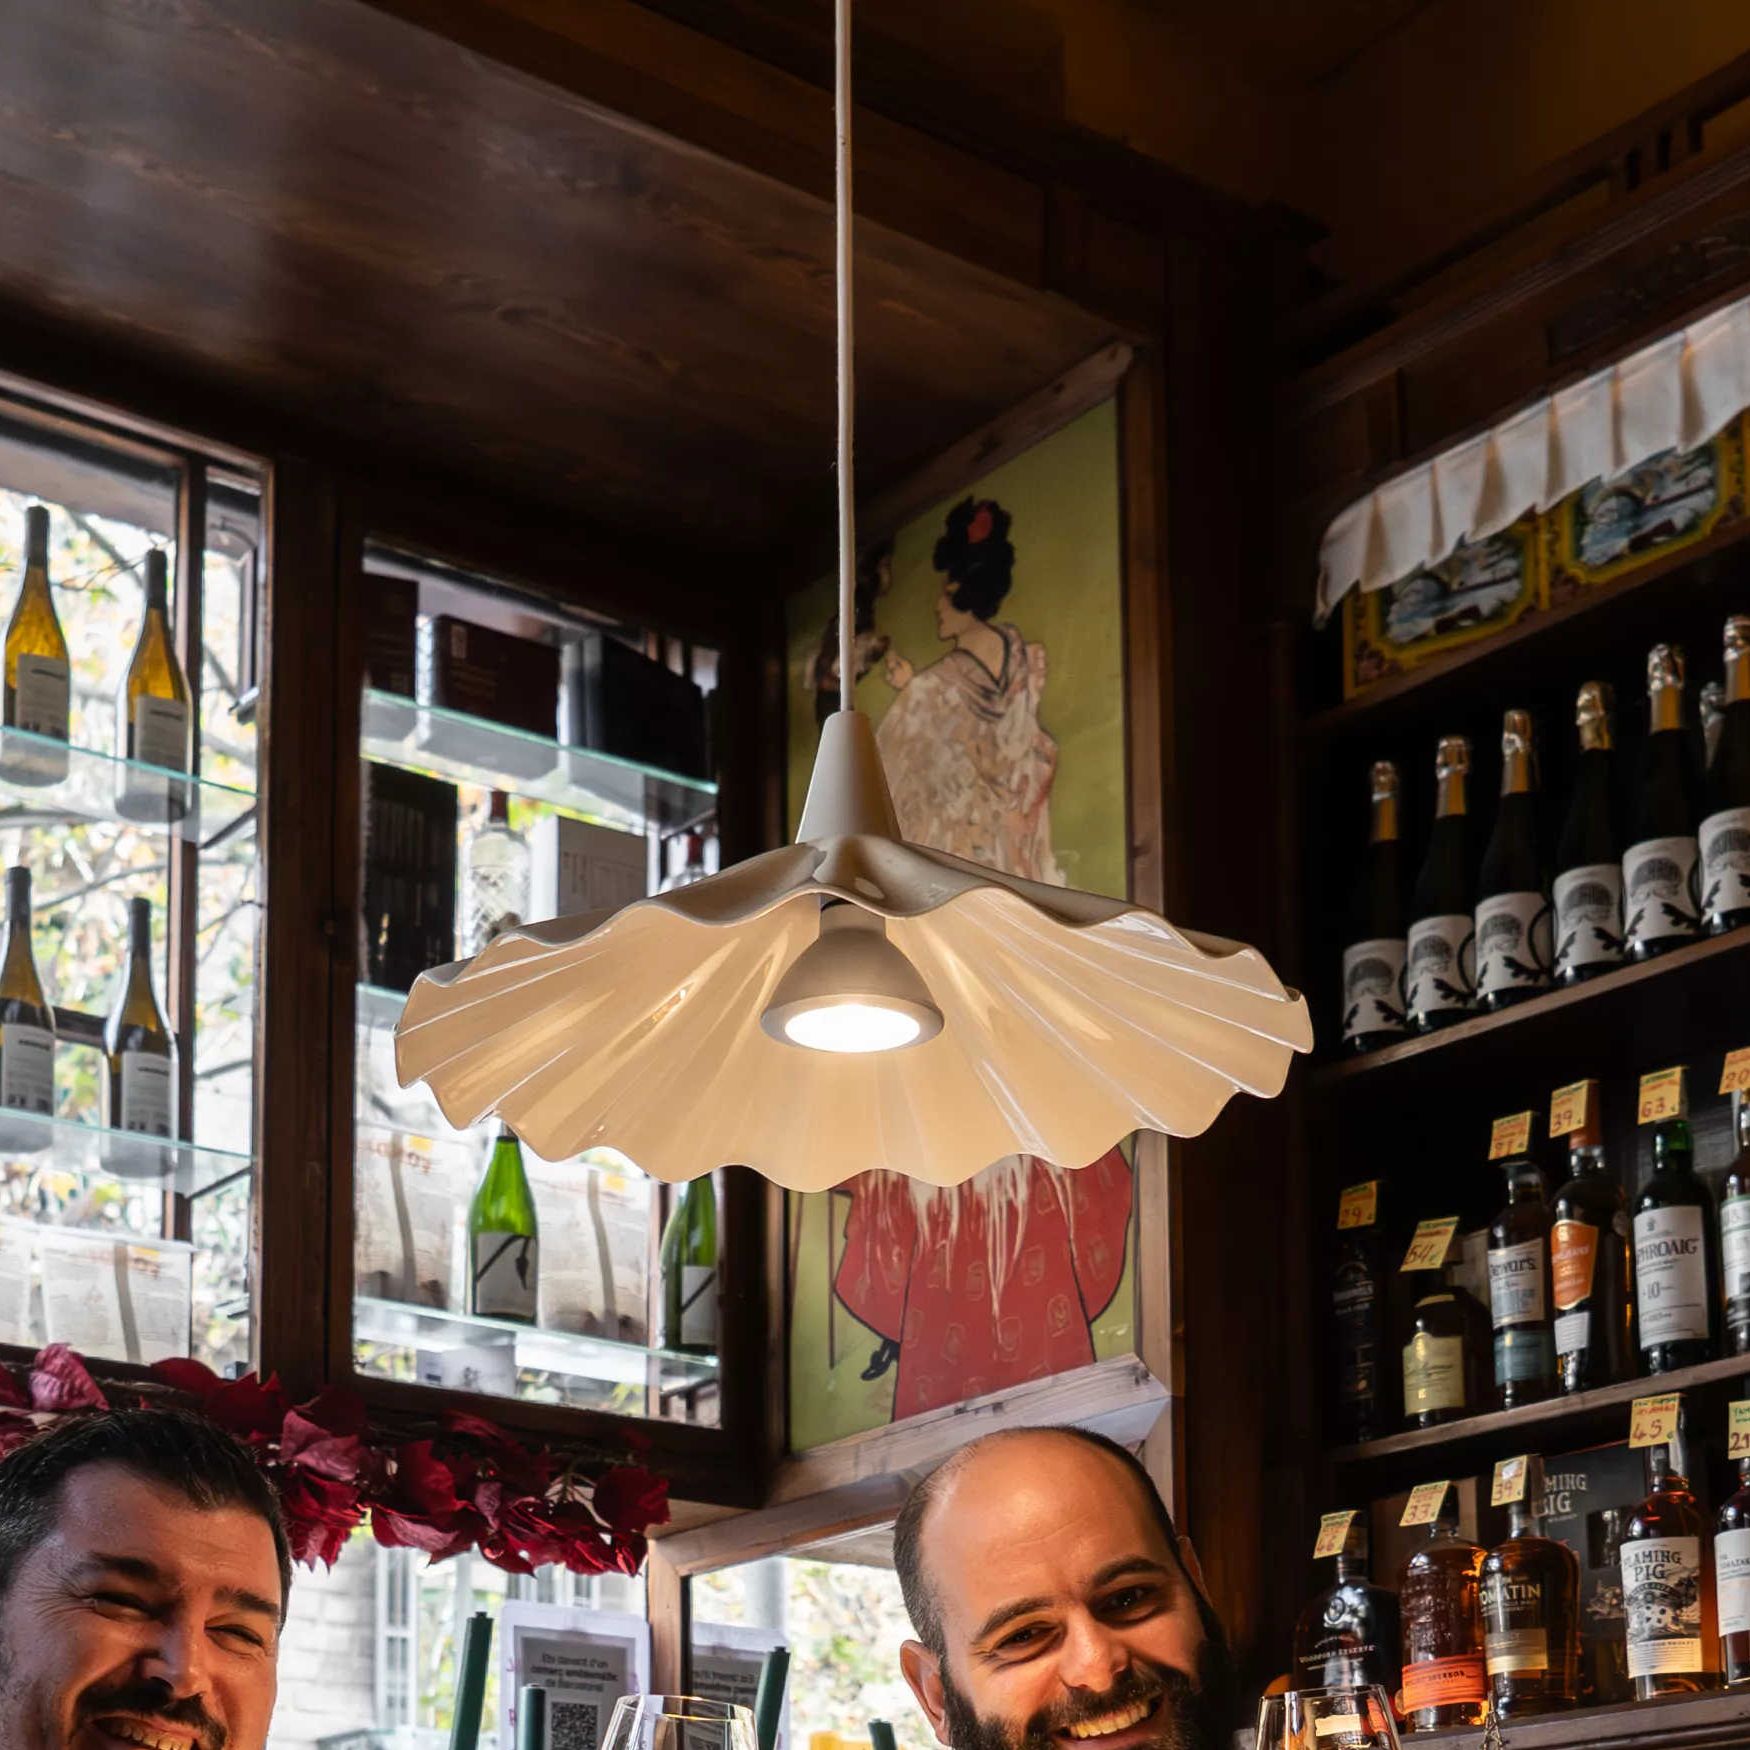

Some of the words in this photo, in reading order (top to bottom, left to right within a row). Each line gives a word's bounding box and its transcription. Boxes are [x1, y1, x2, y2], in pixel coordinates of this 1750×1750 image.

[1632, 1418, 1663, 1441] 45
[1542, 1491, 1572, 1516] IG
[1634, 1564, 1667, 1582] PIG
